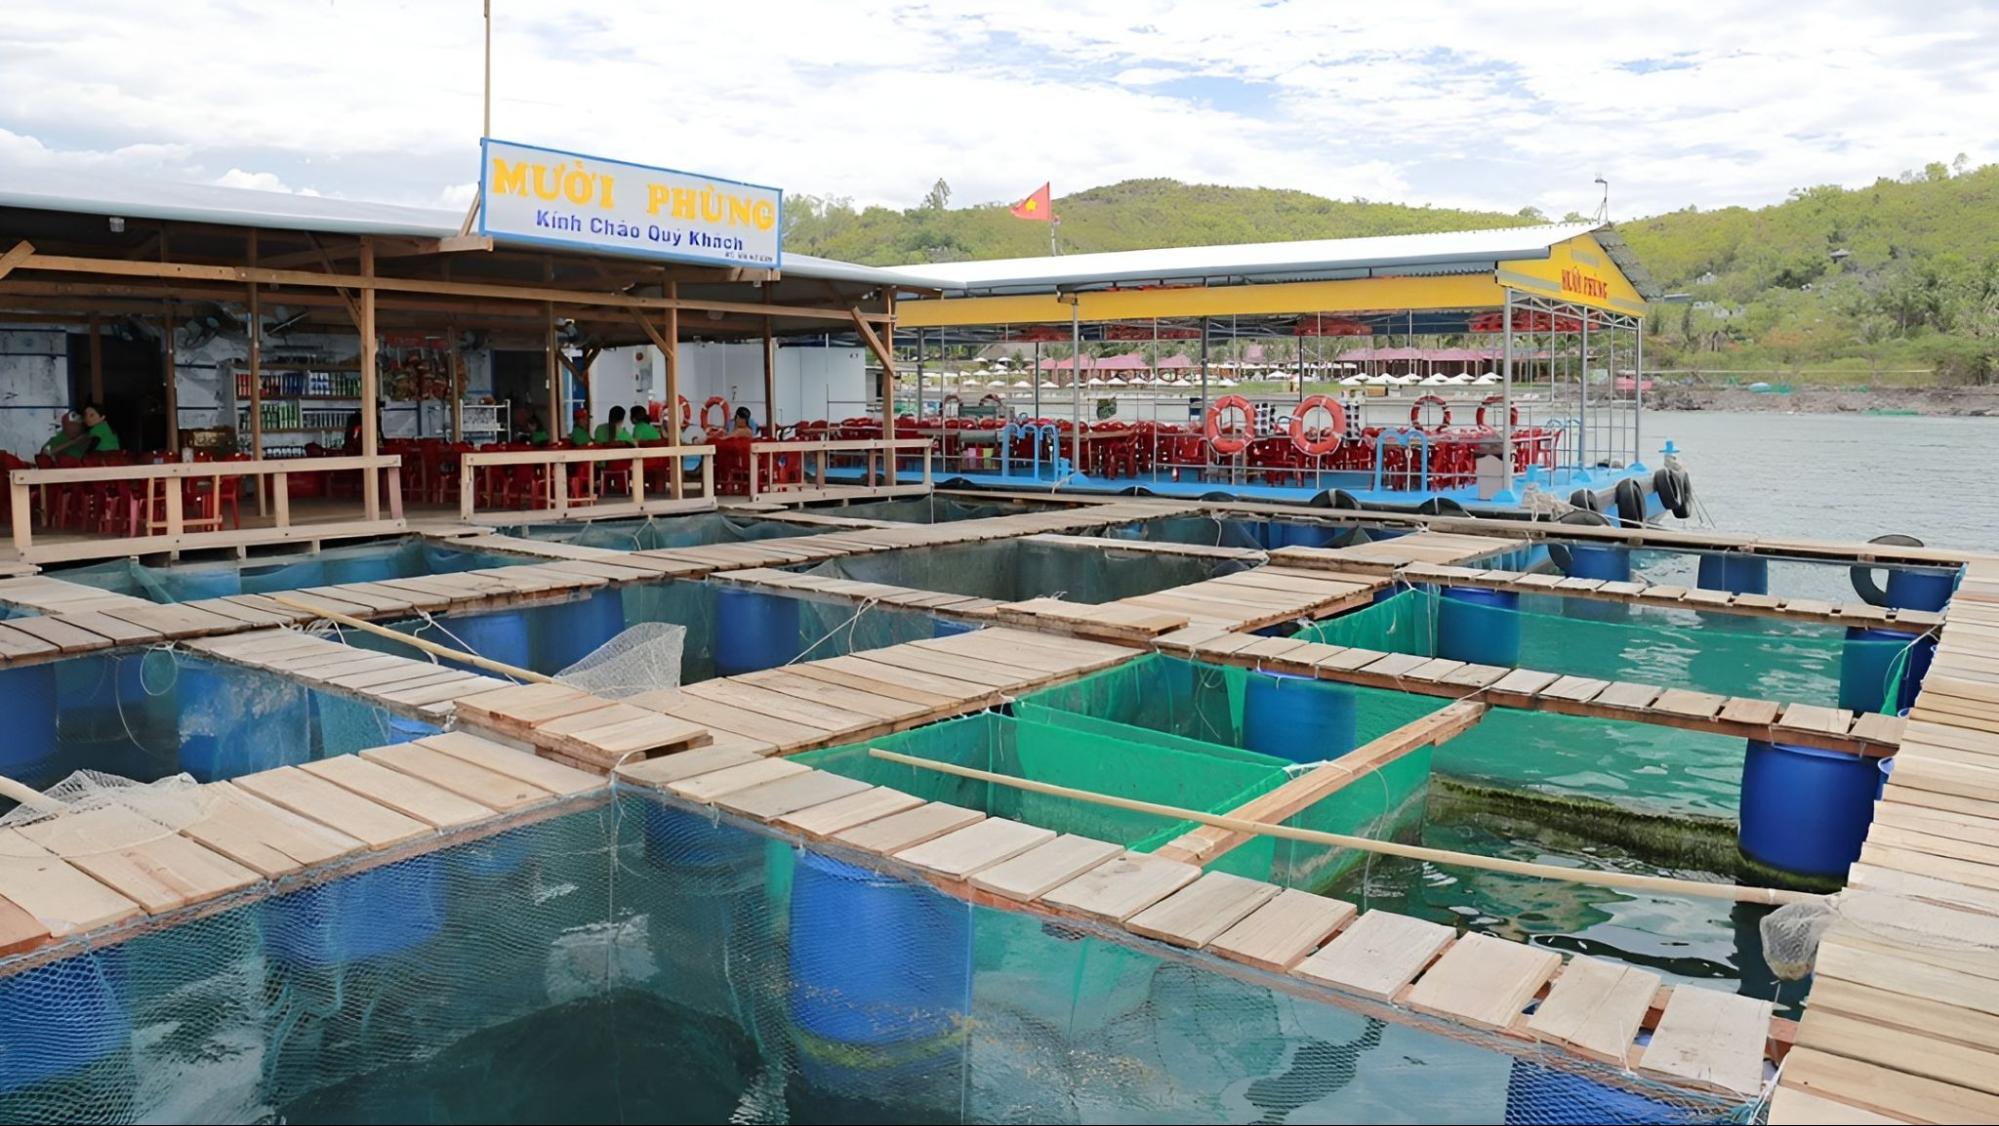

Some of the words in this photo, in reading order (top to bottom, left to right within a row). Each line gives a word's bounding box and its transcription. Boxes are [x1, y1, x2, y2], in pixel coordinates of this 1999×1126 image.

[536, 209, 582, 232] Kính
[648, 224, 681, 246] Quý
[689, 230, 743, 250] Khách
